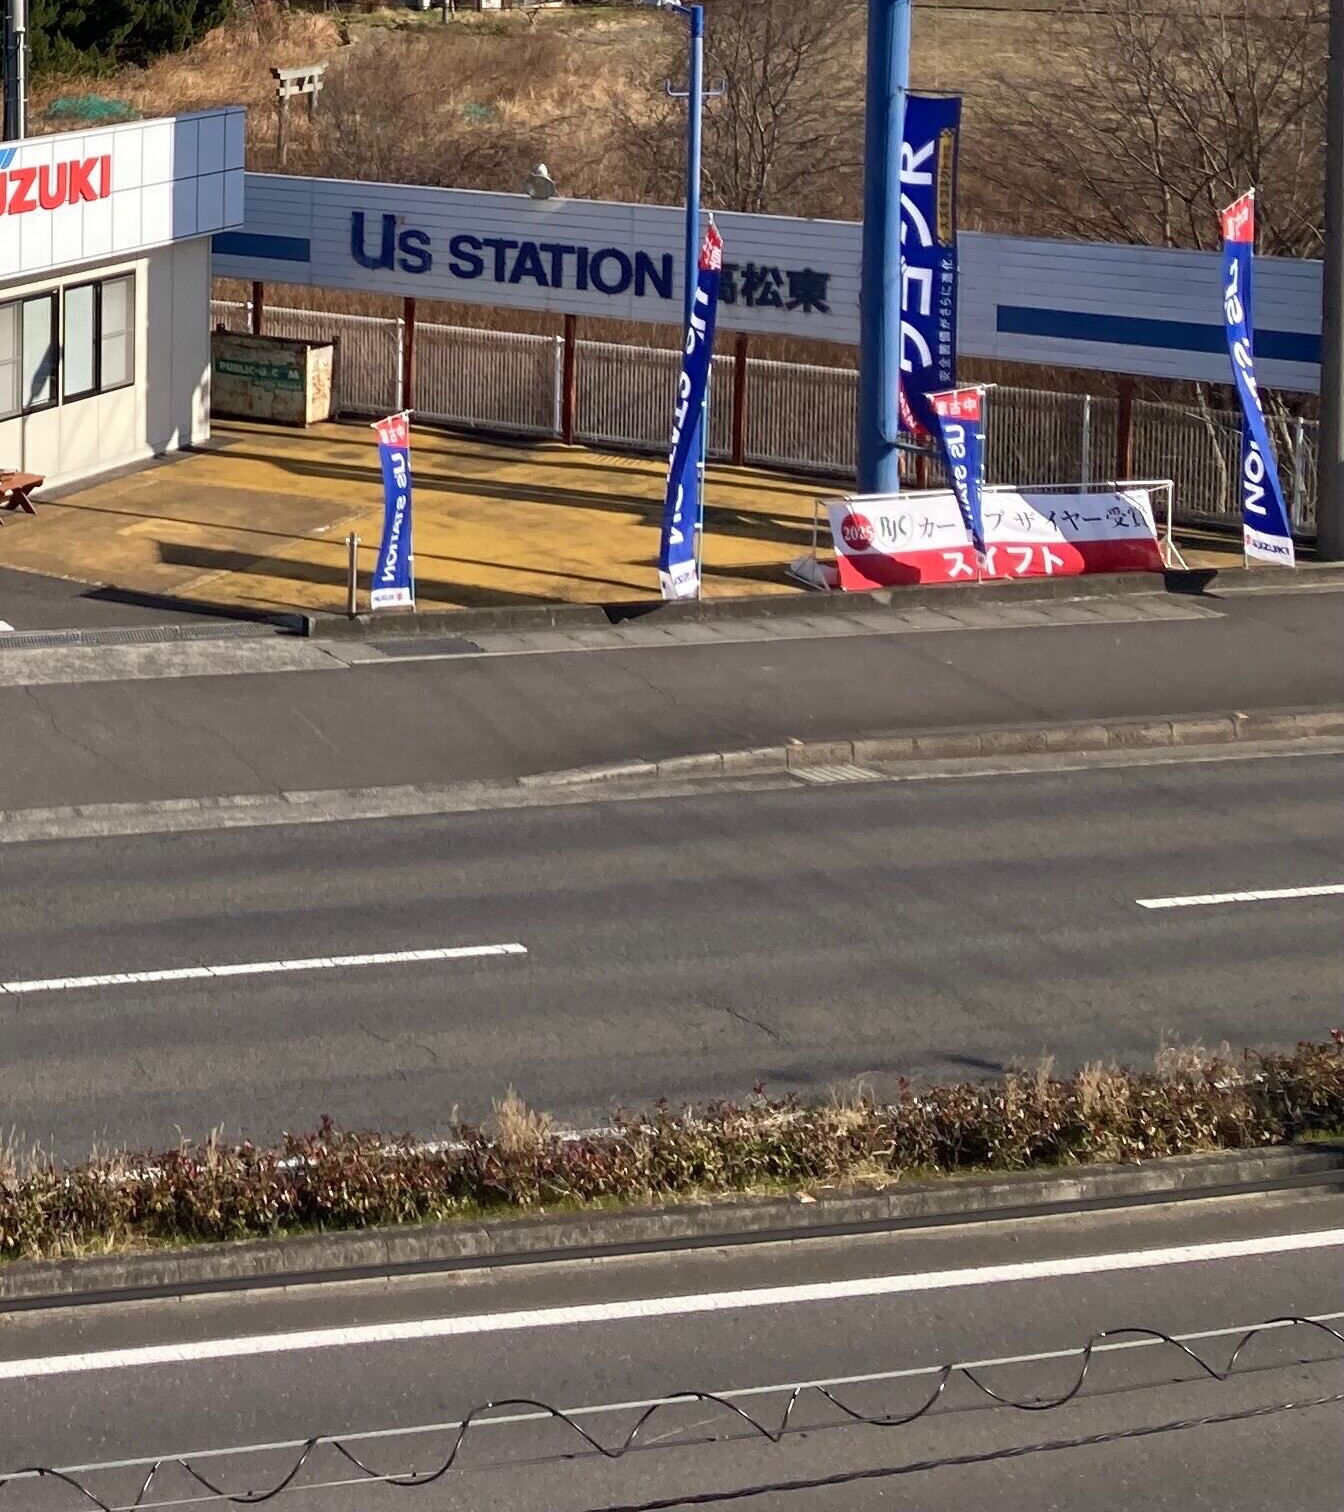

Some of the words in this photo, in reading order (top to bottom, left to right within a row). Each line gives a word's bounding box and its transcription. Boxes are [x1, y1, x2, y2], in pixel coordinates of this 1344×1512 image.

[448, 235, 672, 300] STATION
[942, 545, 1064, 578] スイフト
